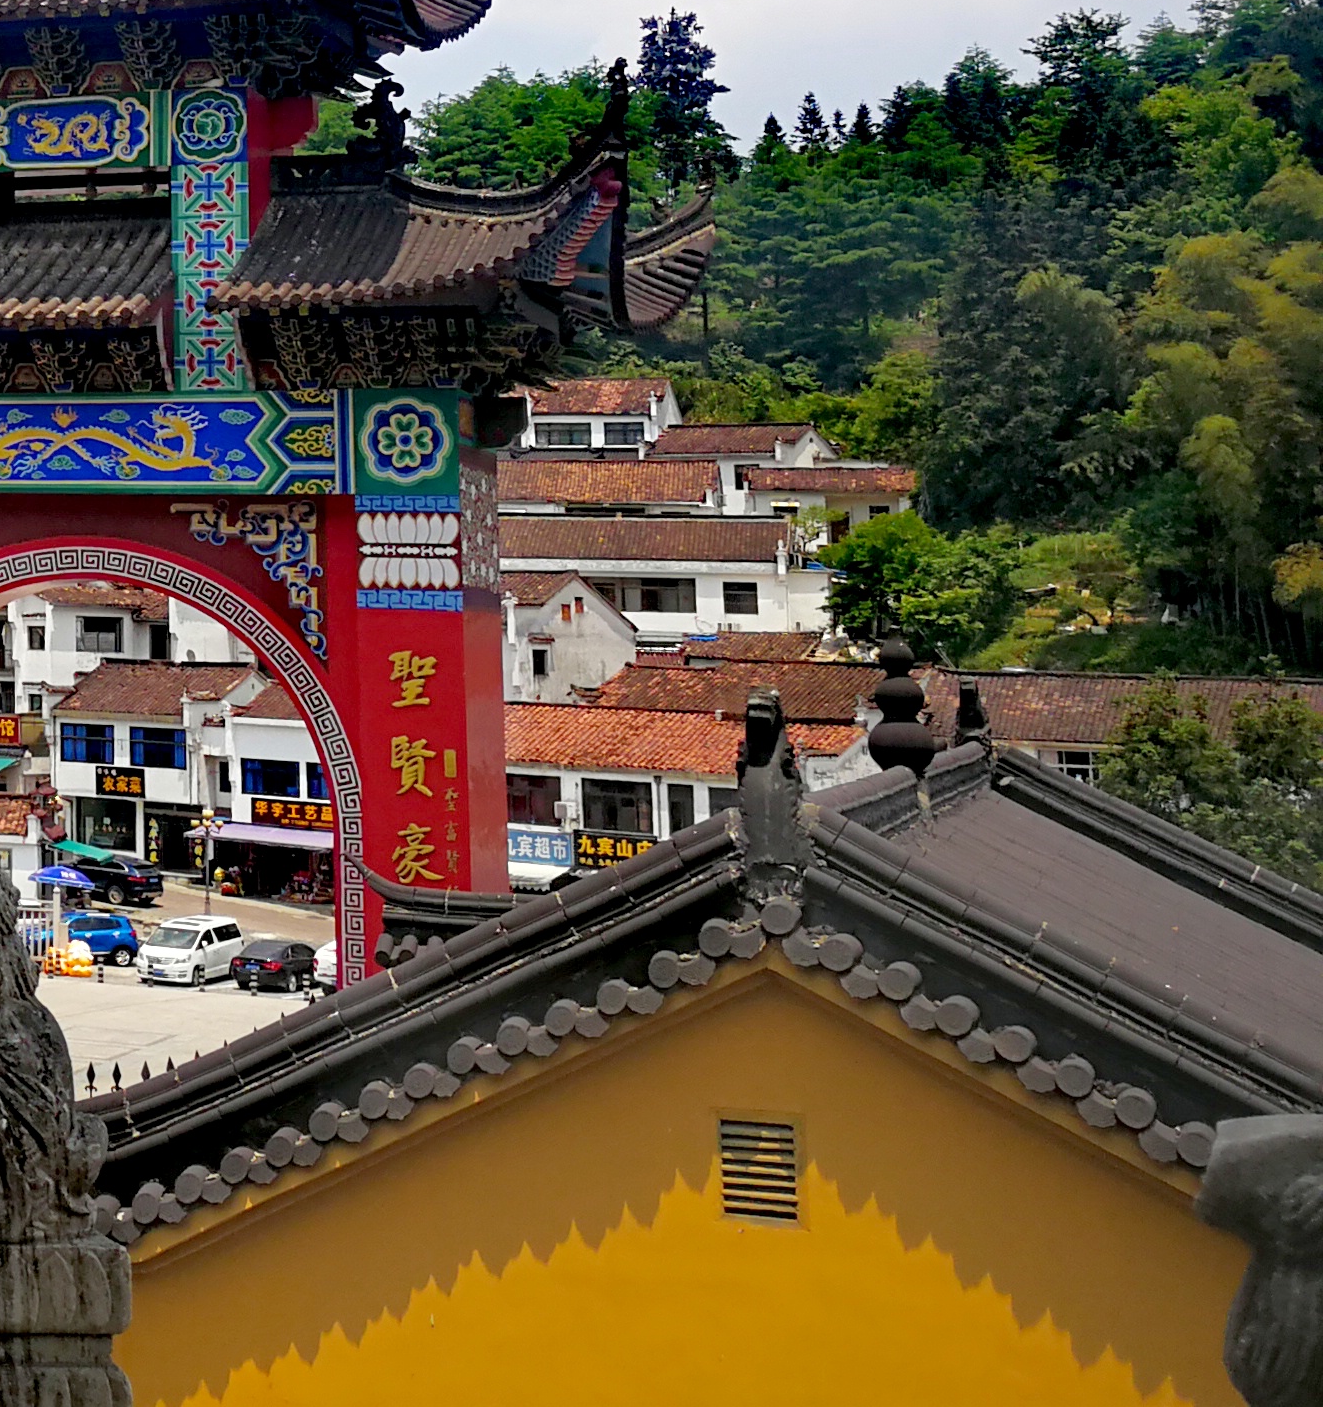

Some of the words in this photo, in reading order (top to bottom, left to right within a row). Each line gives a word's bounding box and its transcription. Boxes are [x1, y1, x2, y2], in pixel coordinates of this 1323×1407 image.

[103, 775, 142, 793] 农家菜
[389, 651, 445, 884] 聖賢豪
